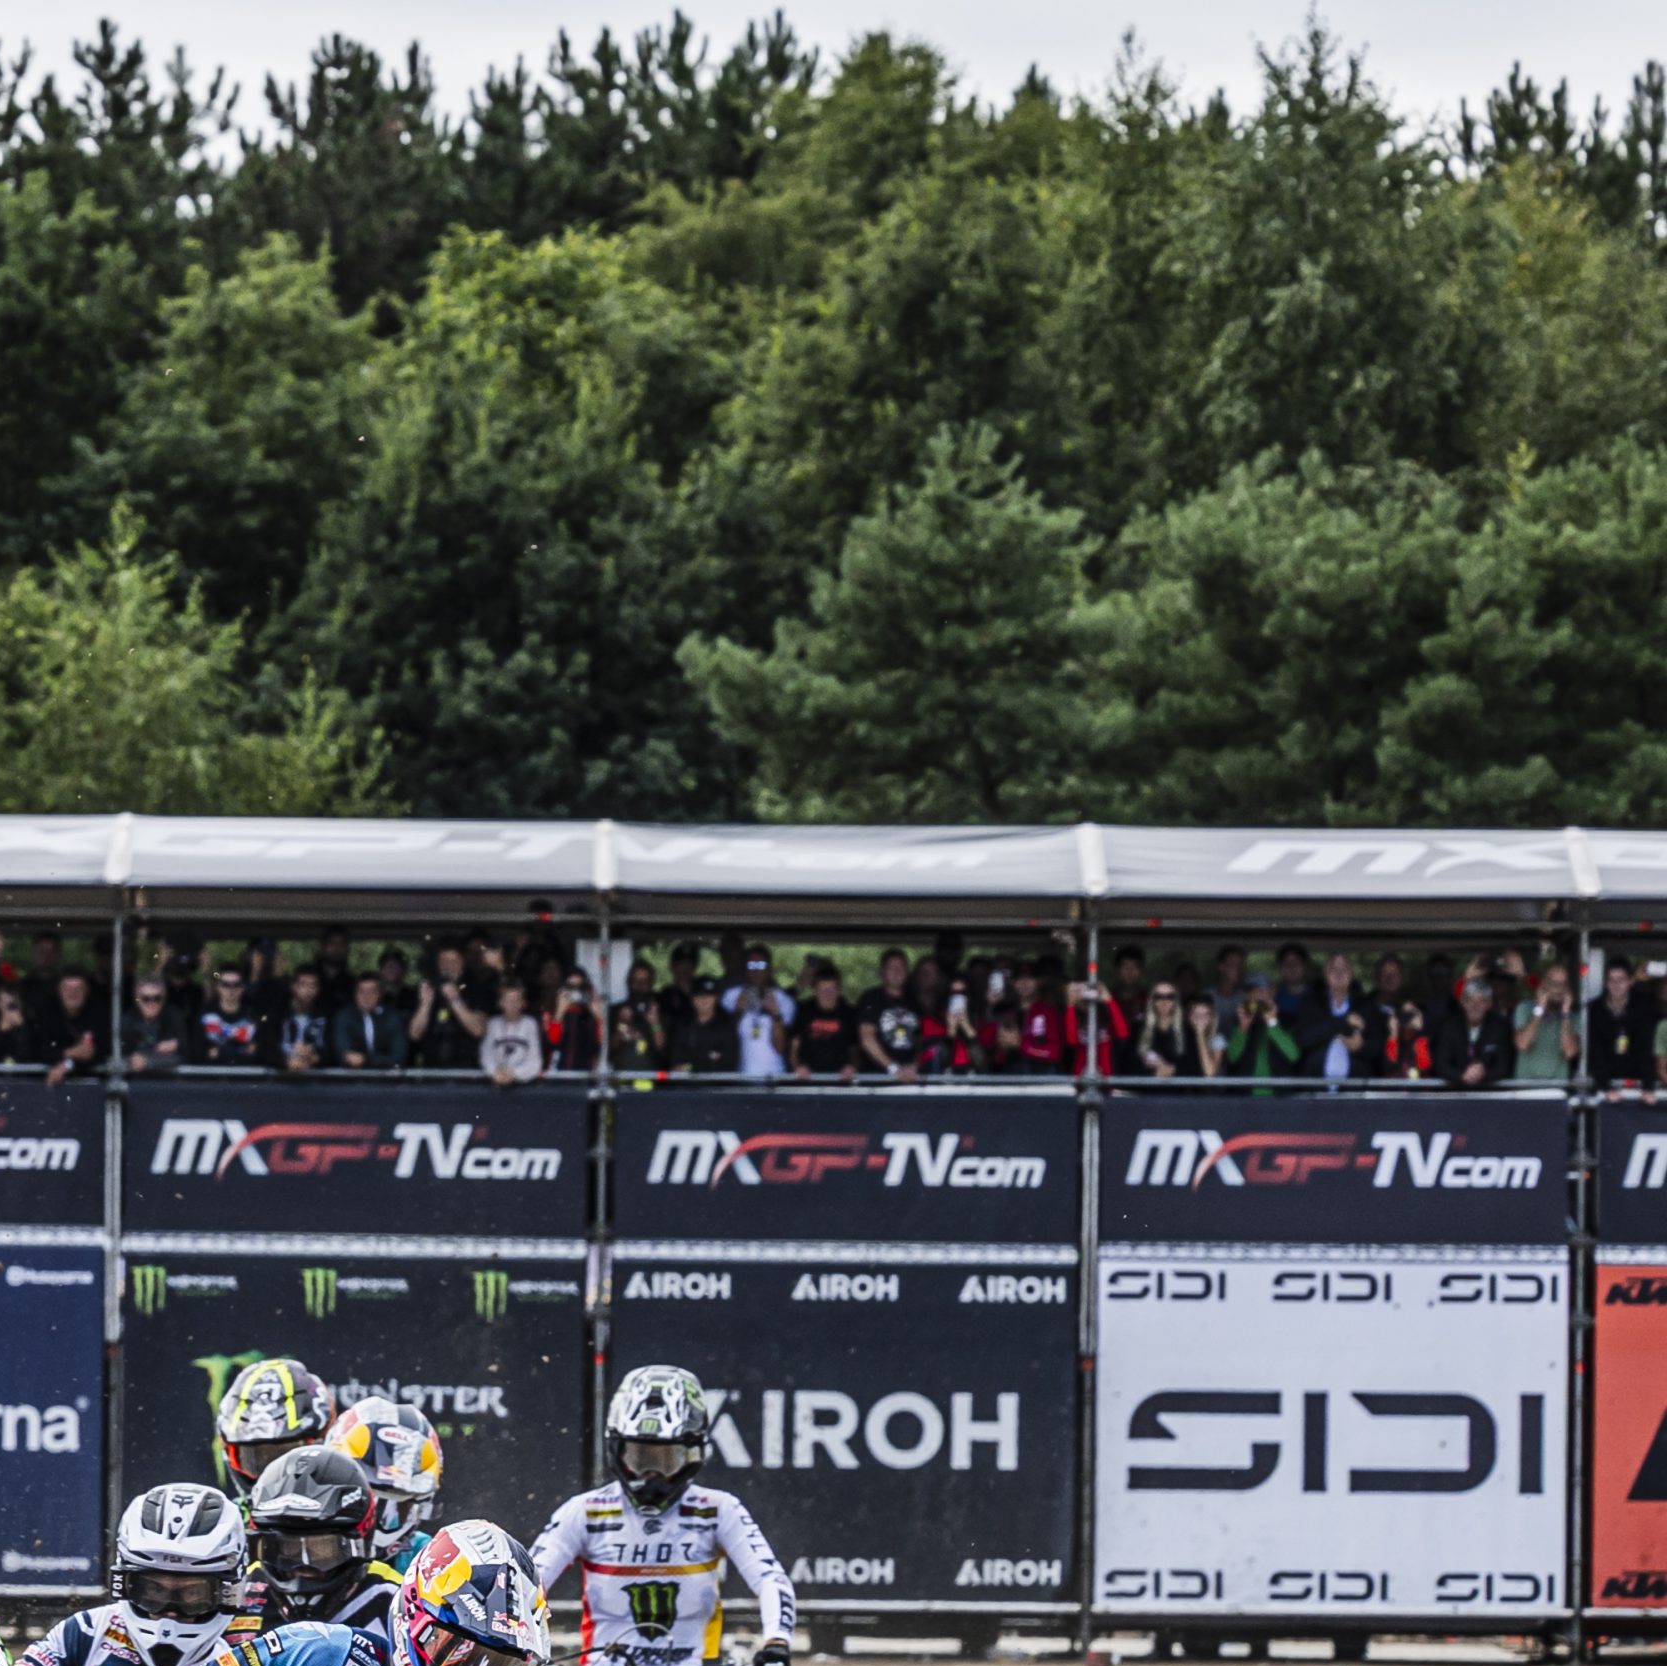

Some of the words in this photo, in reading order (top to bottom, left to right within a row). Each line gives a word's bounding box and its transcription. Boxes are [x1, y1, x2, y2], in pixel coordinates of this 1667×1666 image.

[624, 1272, 733, 1299] AIROH
[792, 1275, 899, 1302] AIROH
[960, 1276, 1066, 1303] AIROH
[1108, 1271, 1227, 1301] SIDI
[1272, 1272, 1392, 1302] SIDI
[1439, 1273, 1559, 1303] SIDI
[1127, 1390, 1545, 1495] SIDI
[791, 1558, 895, 1585] AIROH
[956, 1560, 1062, 1587] AIROH
[1105, 1570, 1224, 1600] SIDI
[1270, 1571, 1389, 1602] SIDI
[1436, 1573, 1555, 1604] SIDI
[458, 1593, 487, 1622] AIROH
